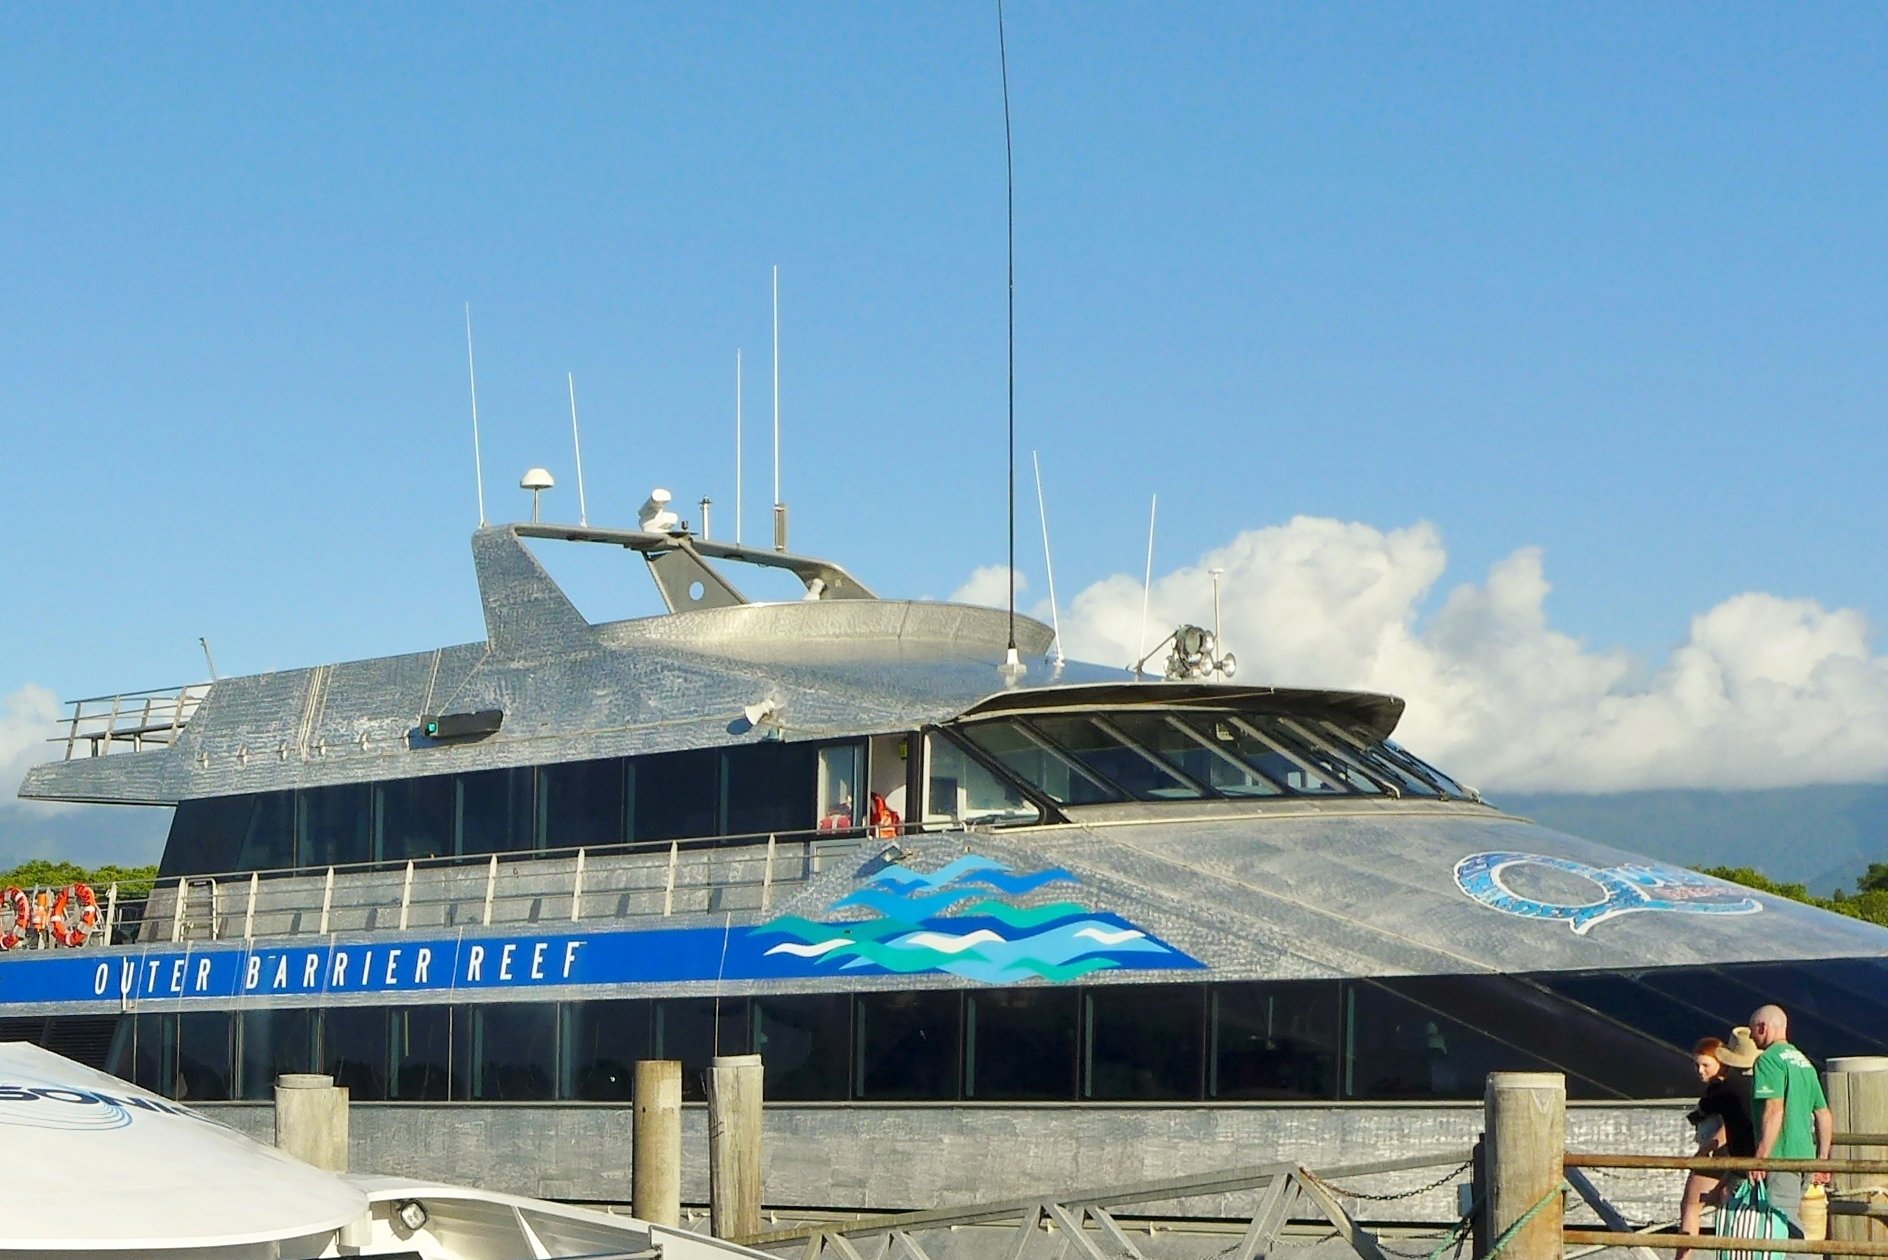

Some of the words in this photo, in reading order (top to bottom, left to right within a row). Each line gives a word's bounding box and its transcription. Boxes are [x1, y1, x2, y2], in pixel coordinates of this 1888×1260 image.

[94, 957, 212, 996] OUTER
[245, 946, 432, 990] BARRIER
[467, 940, 580, 982] REEF
